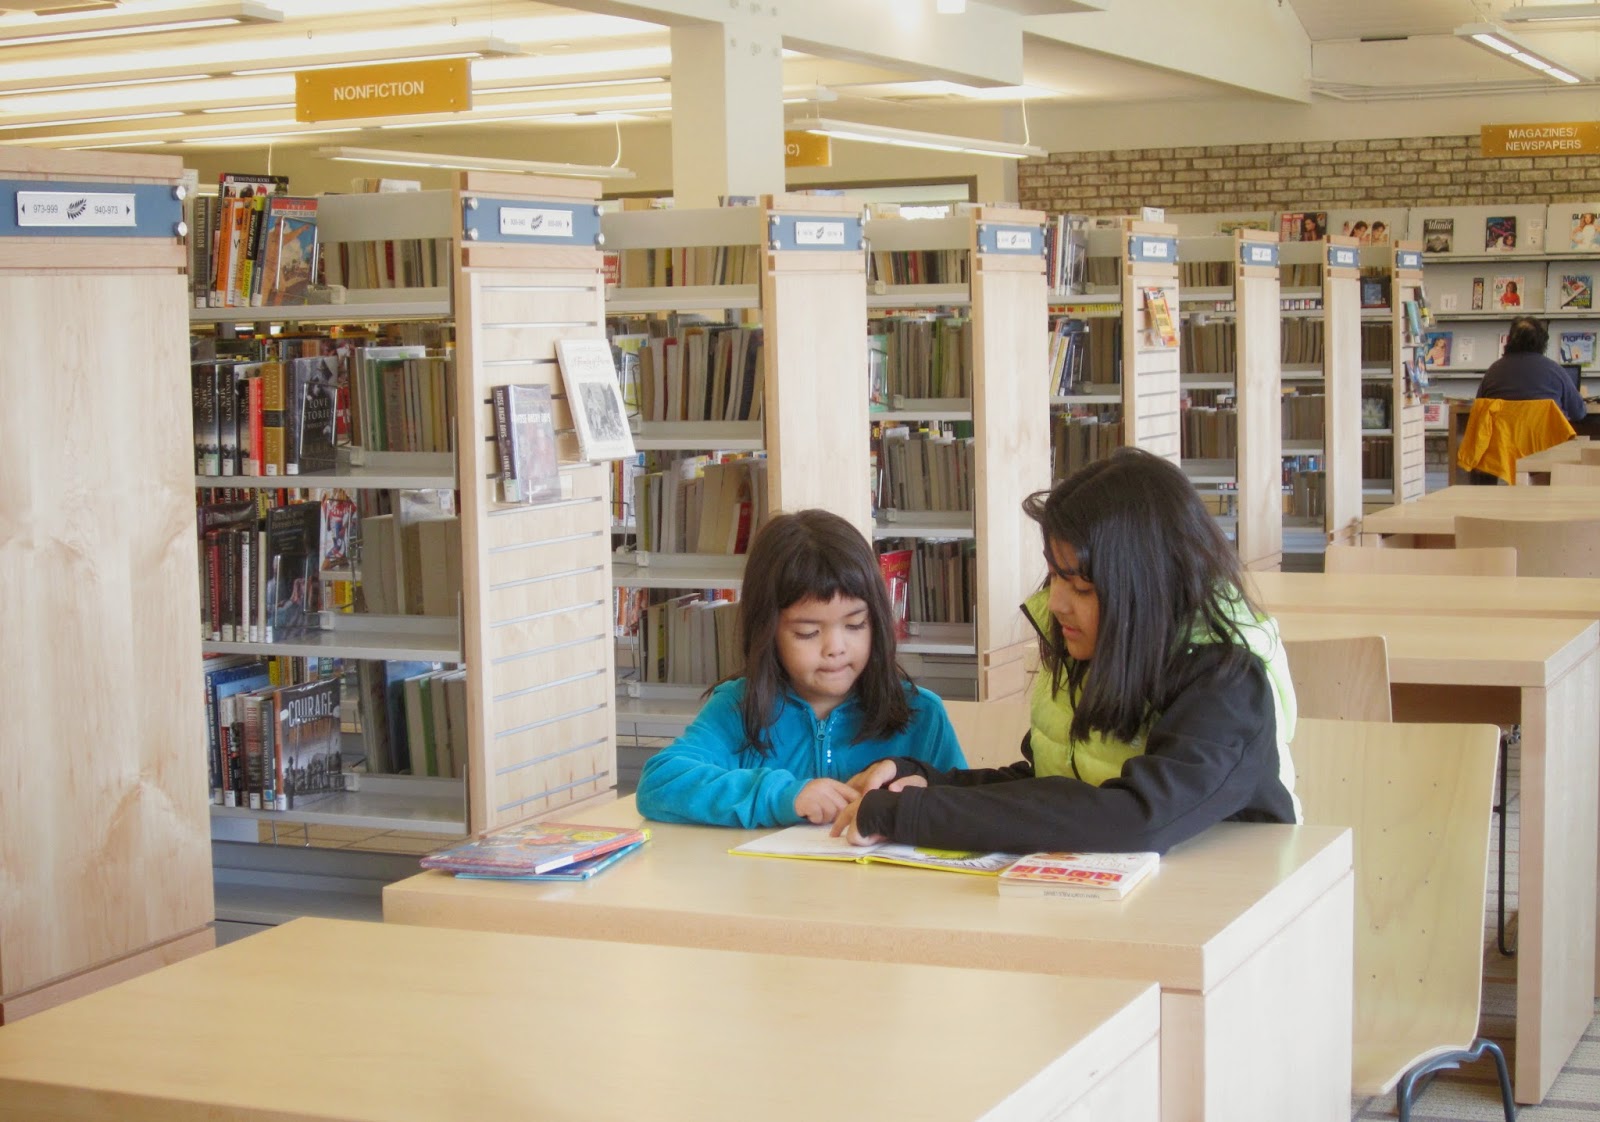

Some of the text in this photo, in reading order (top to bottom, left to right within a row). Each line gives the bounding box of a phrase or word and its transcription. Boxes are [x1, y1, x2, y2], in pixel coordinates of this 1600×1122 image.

[333, 80, 425, 101] NONFICTION
[1508, 127, 1578, 139] MAGAZINES/
[1505, 140, 1582, 151] NEWSPAPERS
[33, 204, 59, 214] 973-999
[94, 205, 119, 215] 940-973
[248, 214, 256, 235] World
[1428, 220, 1453, 230] Atlantic
[197, 217, 205, 248] INVASION
[1563, 275, 1590, 283] Money
[496, 389, 504, 406] THOSE
[308, 398, 328, 409] LOVE
[303, 410, 334, 420] STORIES
[498, 407, 506, 424] ANGRY
[288, 690, 333, 727] COURAGE
